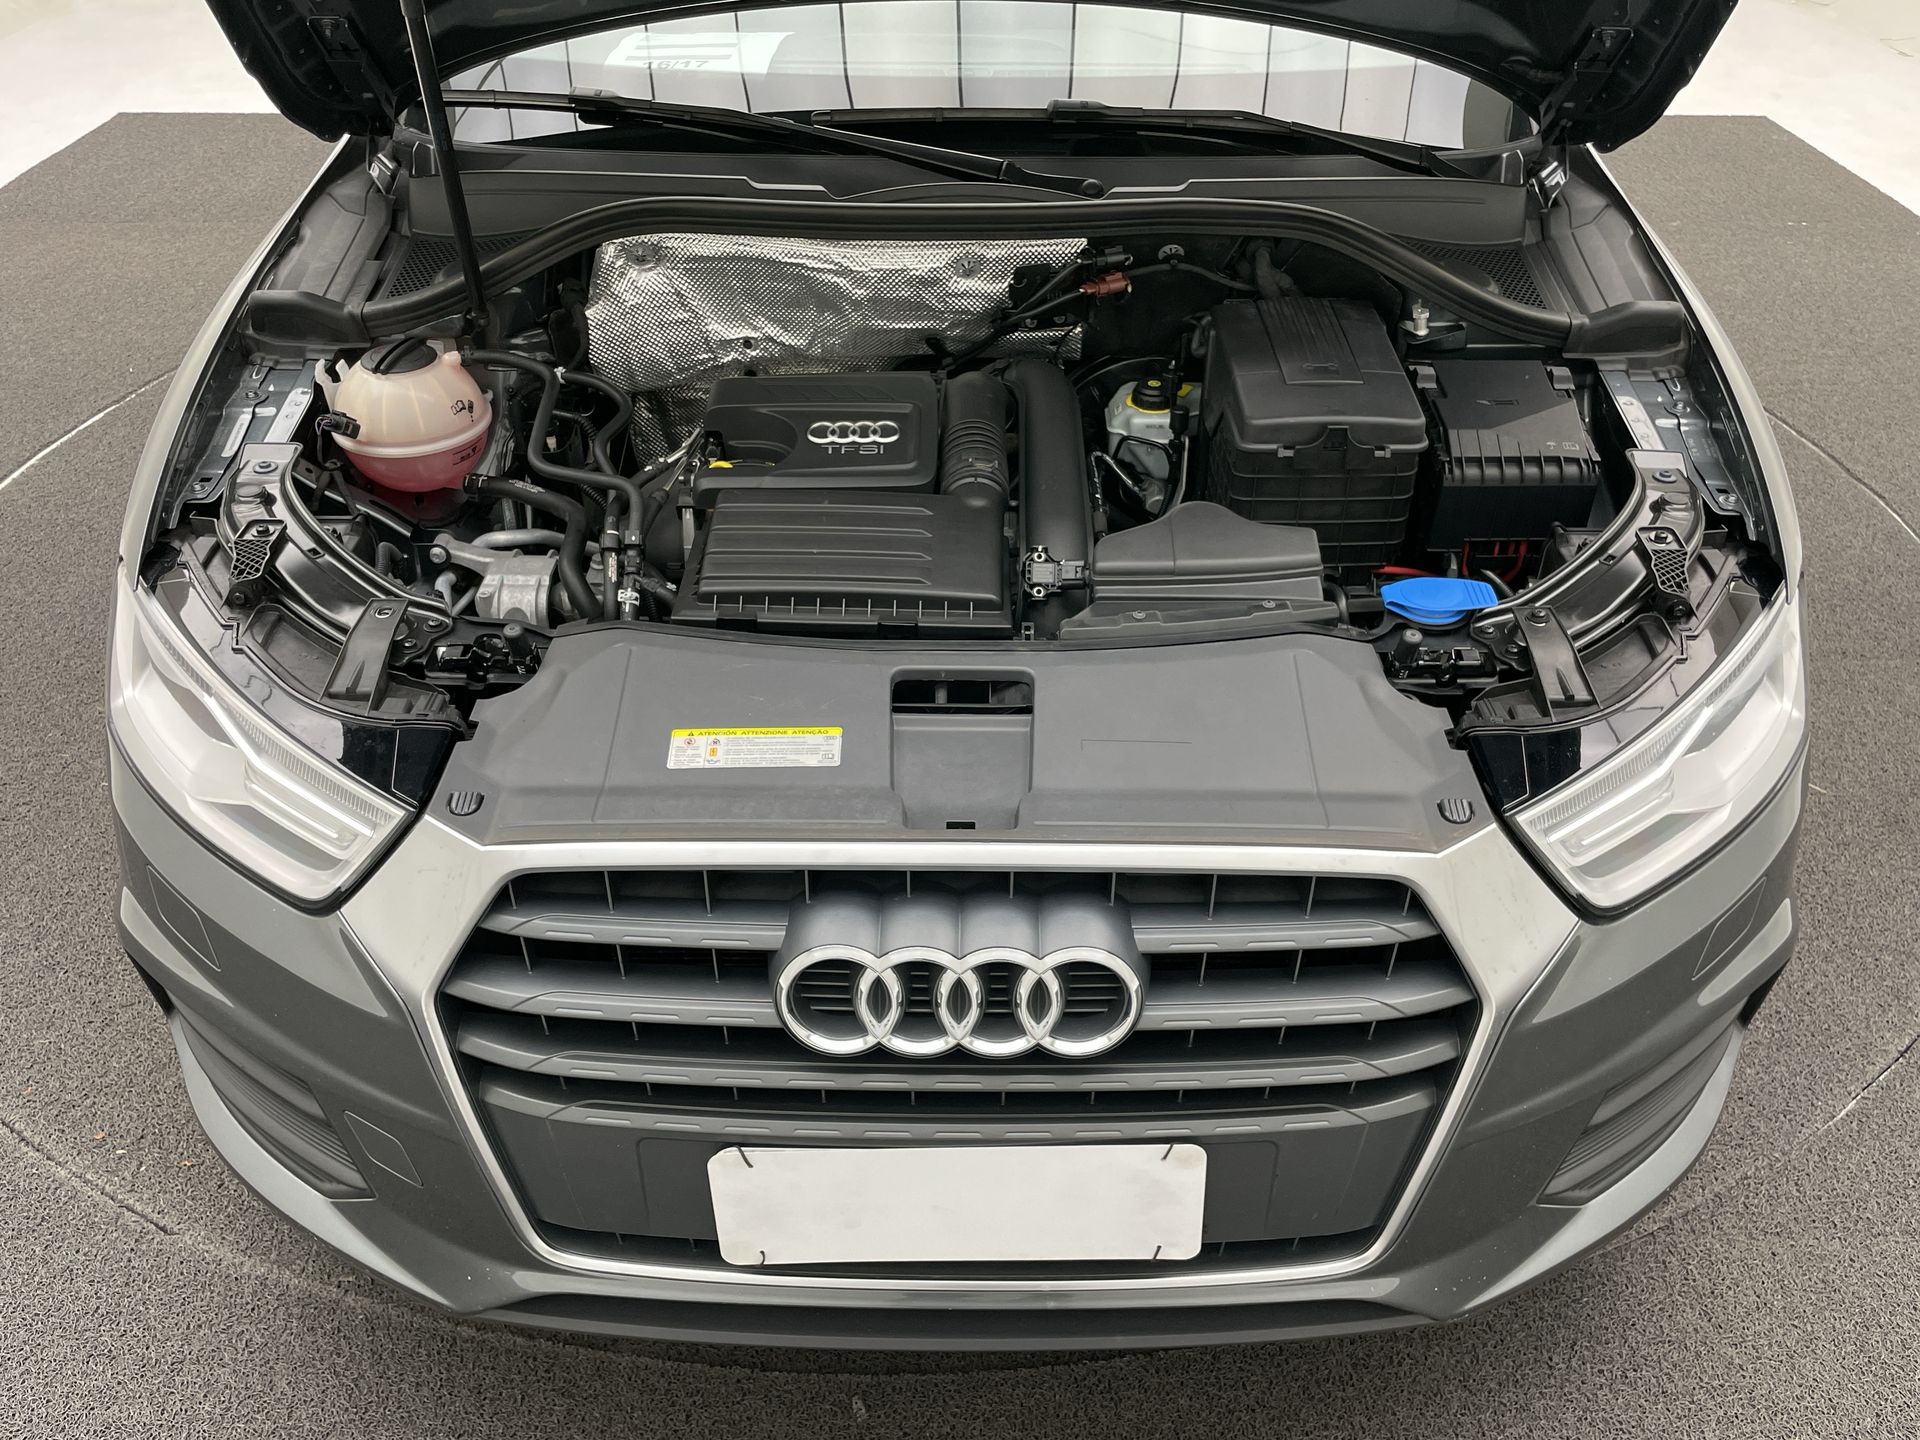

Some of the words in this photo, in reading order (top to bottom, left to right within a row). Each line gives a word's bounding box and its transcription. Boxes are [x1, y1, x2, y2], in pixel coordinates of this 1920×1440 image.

[643, 60, 709, 70] 16/17
[821, 444, 884, 454] TFSI
[792, 728, 829, 736] ATENÇÃO
